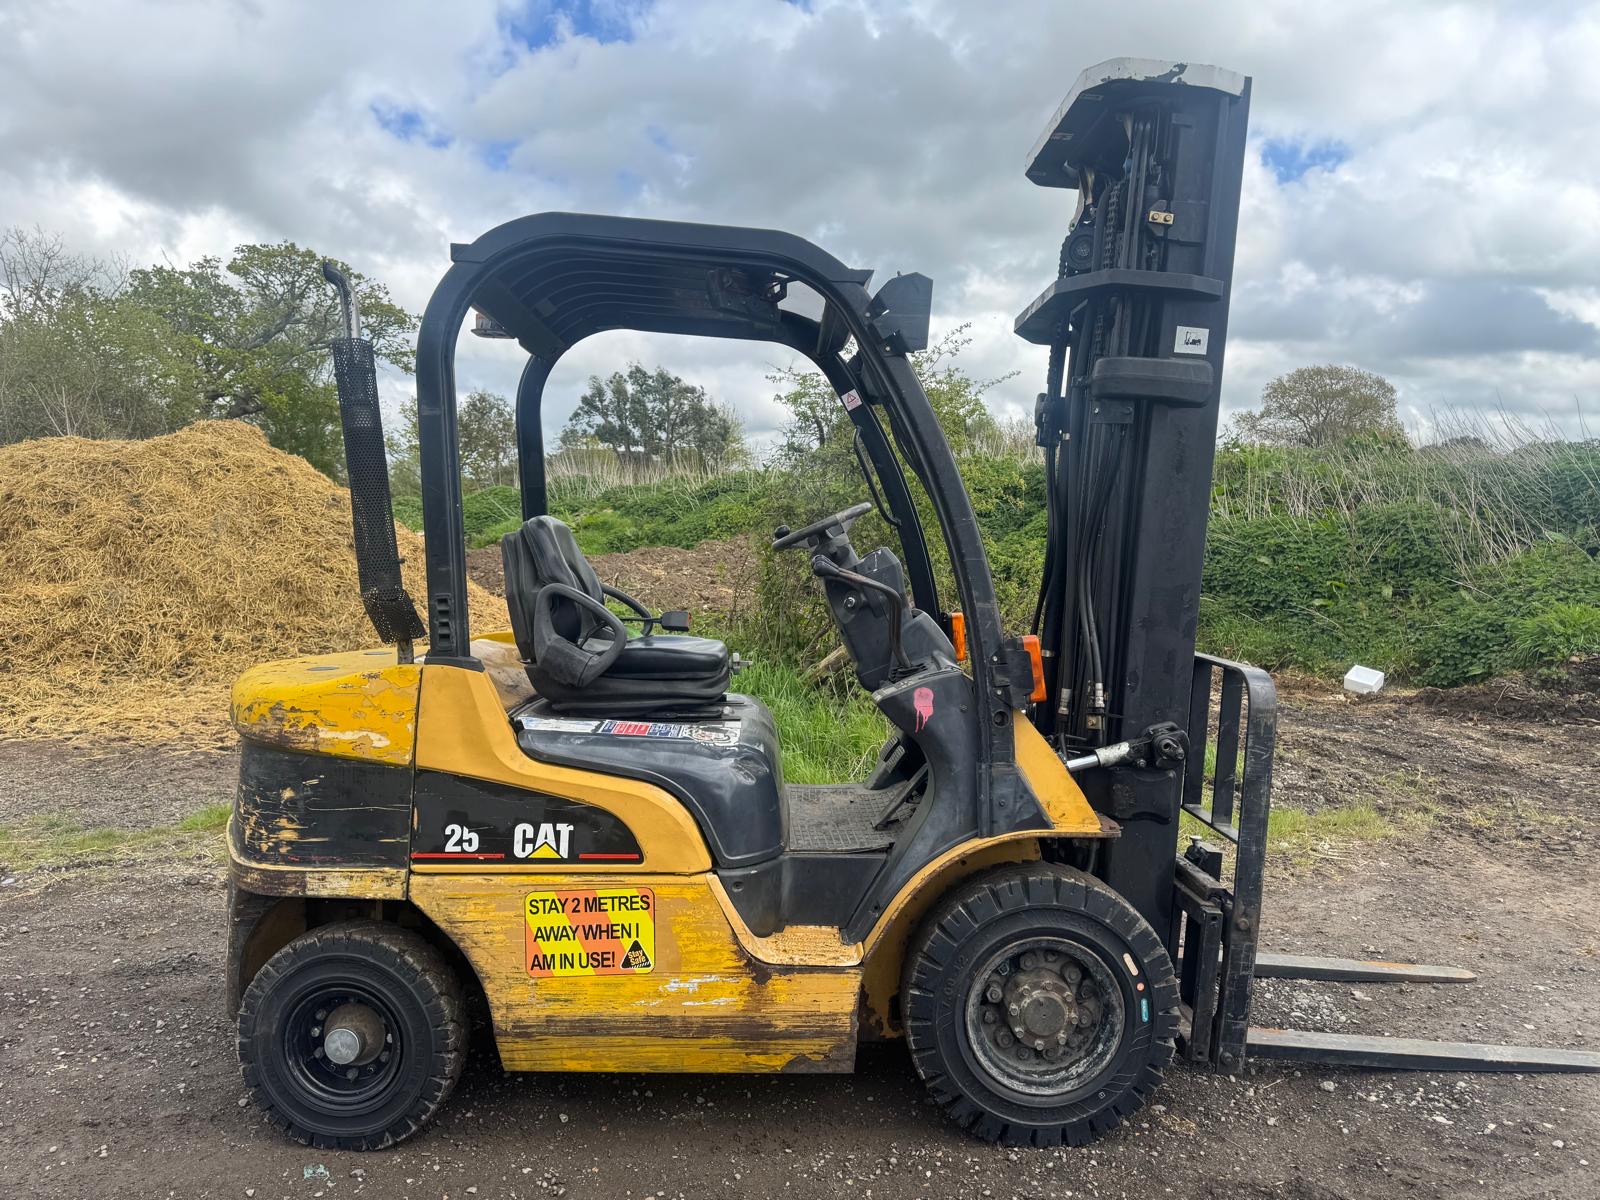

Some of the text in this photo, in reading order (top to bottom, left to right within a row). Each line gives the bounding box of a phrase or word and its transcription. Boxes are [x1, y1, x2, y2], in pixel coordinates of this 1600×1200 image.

[444, 823, 479, 853] 25
[513, 822, 574, 859] CAT
[529, 895, 650, 915] STAY 2 METRES
[533, 923, 640, 942] AWAY WHEN I
[530, 951, 615, 971] AM IN USE!
[627, 950, 643, 959] Stay
[630, 956, 646, 966] Safe
